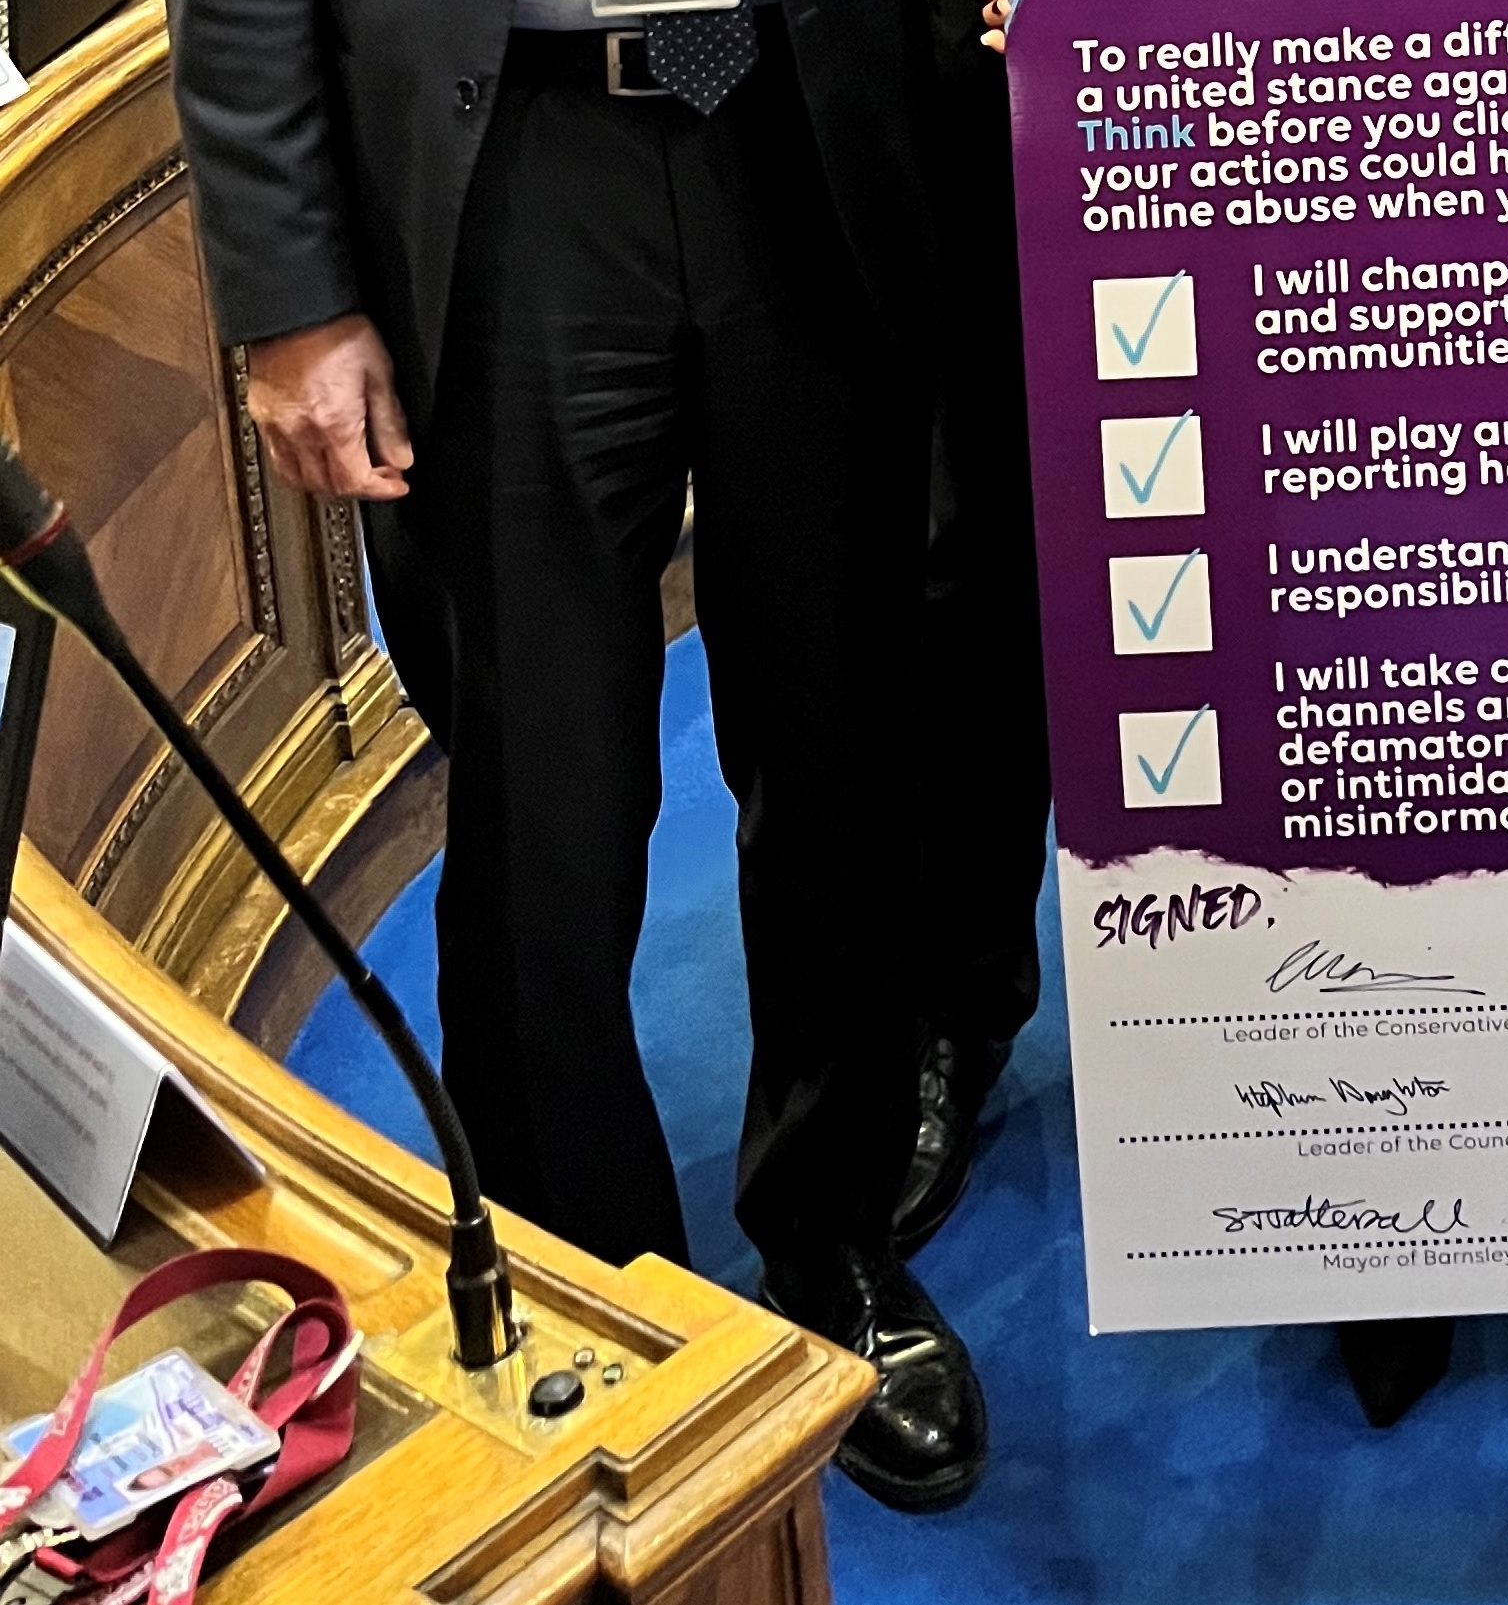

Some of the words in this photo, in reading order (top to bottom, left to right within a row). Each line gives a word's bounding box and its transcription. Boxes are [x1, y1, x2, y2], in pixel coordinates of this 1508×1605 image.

[1072, 39, 1126, 73] To
[1138, 31, 1261, 78] really
[1272, 26, 1394, 65] make
[1404, 33, 1431, 60] a
[1076, 86, 1103, 113] a
[1116, 66, 1255, 112] united
[1267, 72, 1413, 105] stance
[1077, 114, 1196, 151] Think
[1208, 108, 1352, 147] before
[1362, 111, 1441, 150] you
[1080, 162, 1179, 202] your
[1189, 149, 1349, 188] actions
[1359, 140, 1476, 180] could
[1083, 194, 1215, 232] online
[1225, 189, 1357, 226] abuse
[1367, 182, 1485, 219] when
[1253, 264, 1264, 297] I
[1275, 258, 1349, 295] will
[1255, 297, 1337, 335] and
[1262, 423, 1272, 456] I
[1283, 418, 1357, 455] will
[1370, 415, 1463, 460] play
[1264, 454, 1467, 501] reporting
[1268, 543, 1278, 575] I
[1275, 661, 1285, 692] I
[1296, 656, 1369, 691] will
[1380, 653, 1479, 688] take
[1276, 690, 1466, 729] channels
[1281, 777, 1324, 803] or
[1223, 1023, 1300, 1043] Leader
[1305, 1021, 1328, 1040] of
[1334, 1020, 1369, 1039] the
[1297, 1138, 1374, 1158] Leader
[1380, 1135, 1401, 1154] of
[1407, 1134, 1442, 1153] the
[1323, 1253, 1391, 1274] Mayor
[1396, 1248, 1418, 1268] of
